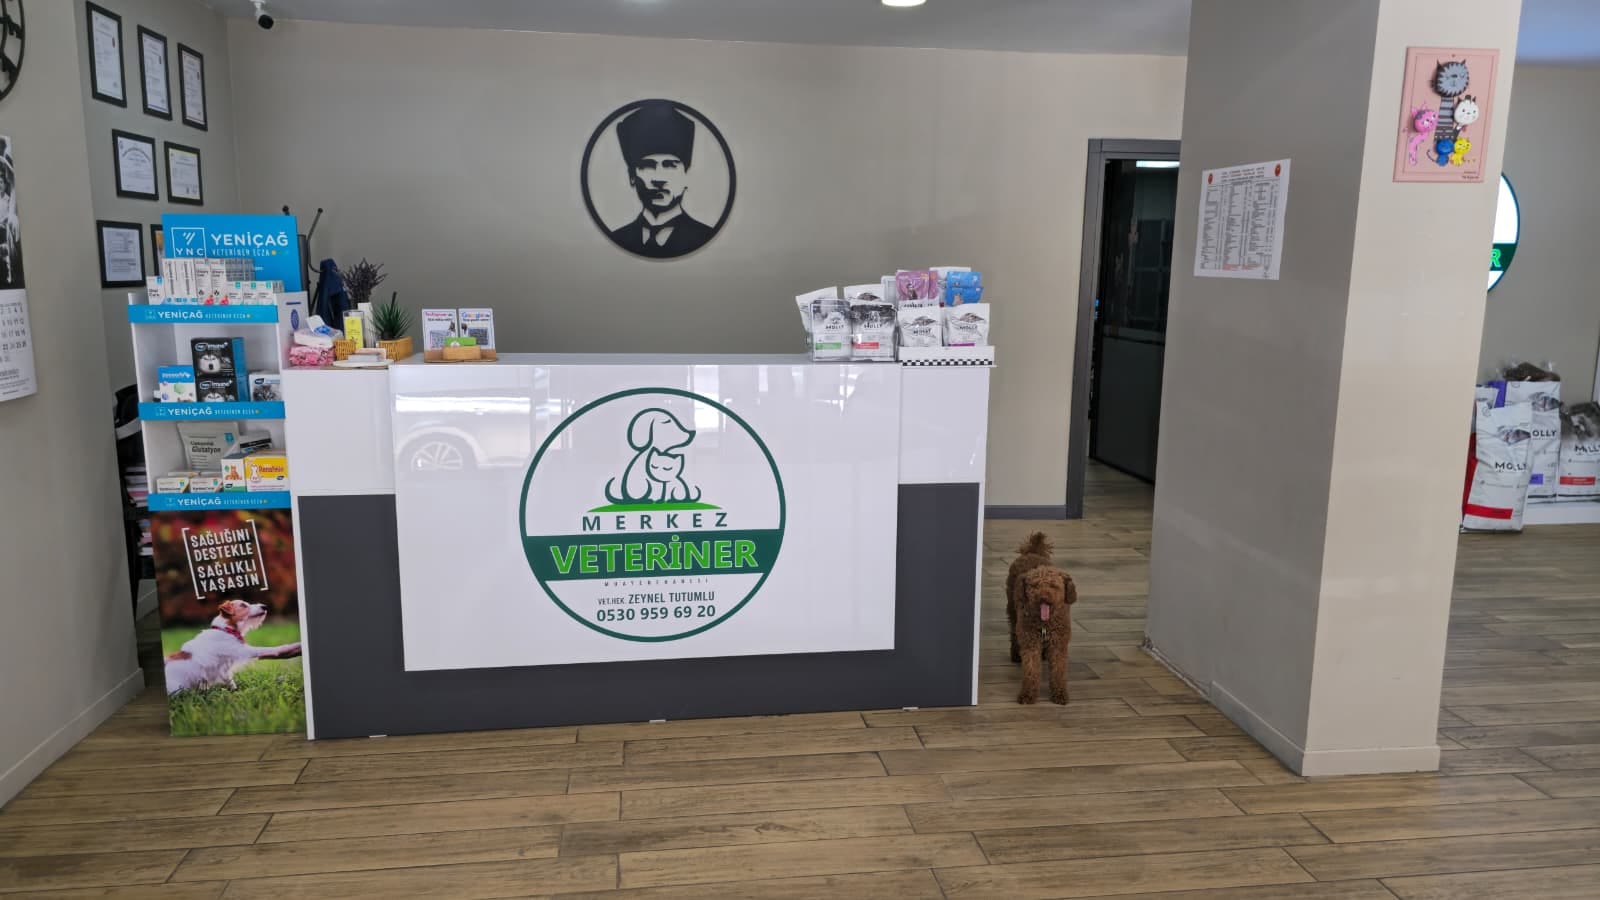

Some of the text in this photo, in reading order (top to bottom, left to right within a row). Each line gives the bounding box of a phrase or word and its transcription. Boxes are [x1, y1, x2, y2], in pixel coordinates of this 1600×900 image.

[211, 231, 289, 249] YENİÇAĞ
[175, 248, 205, 256] YNC
[157, 310, 203, 319] YENİÇAĞ
[167, 406, 213, 416] YENİÇAĞ
[177, 496, 221, 506] YENİÇAĞ
[582, 512, 728, 531] MERKEZ
[190, 528, 250, 548] SAĞLIĞINI
[193, 542, 254, 562] DESTEKLE
[550, 535, 759, 574] VETERİNER
[197, 559, 257, 579] SAĞLIKLI
[200, 573, 260, 593] YAŞASIN
[628, 593, 666, 605] ZEYNEL
[669, 591, 715, 603] TUTUMLU
[596, 605, 716, 622] 0530 959 69 20
